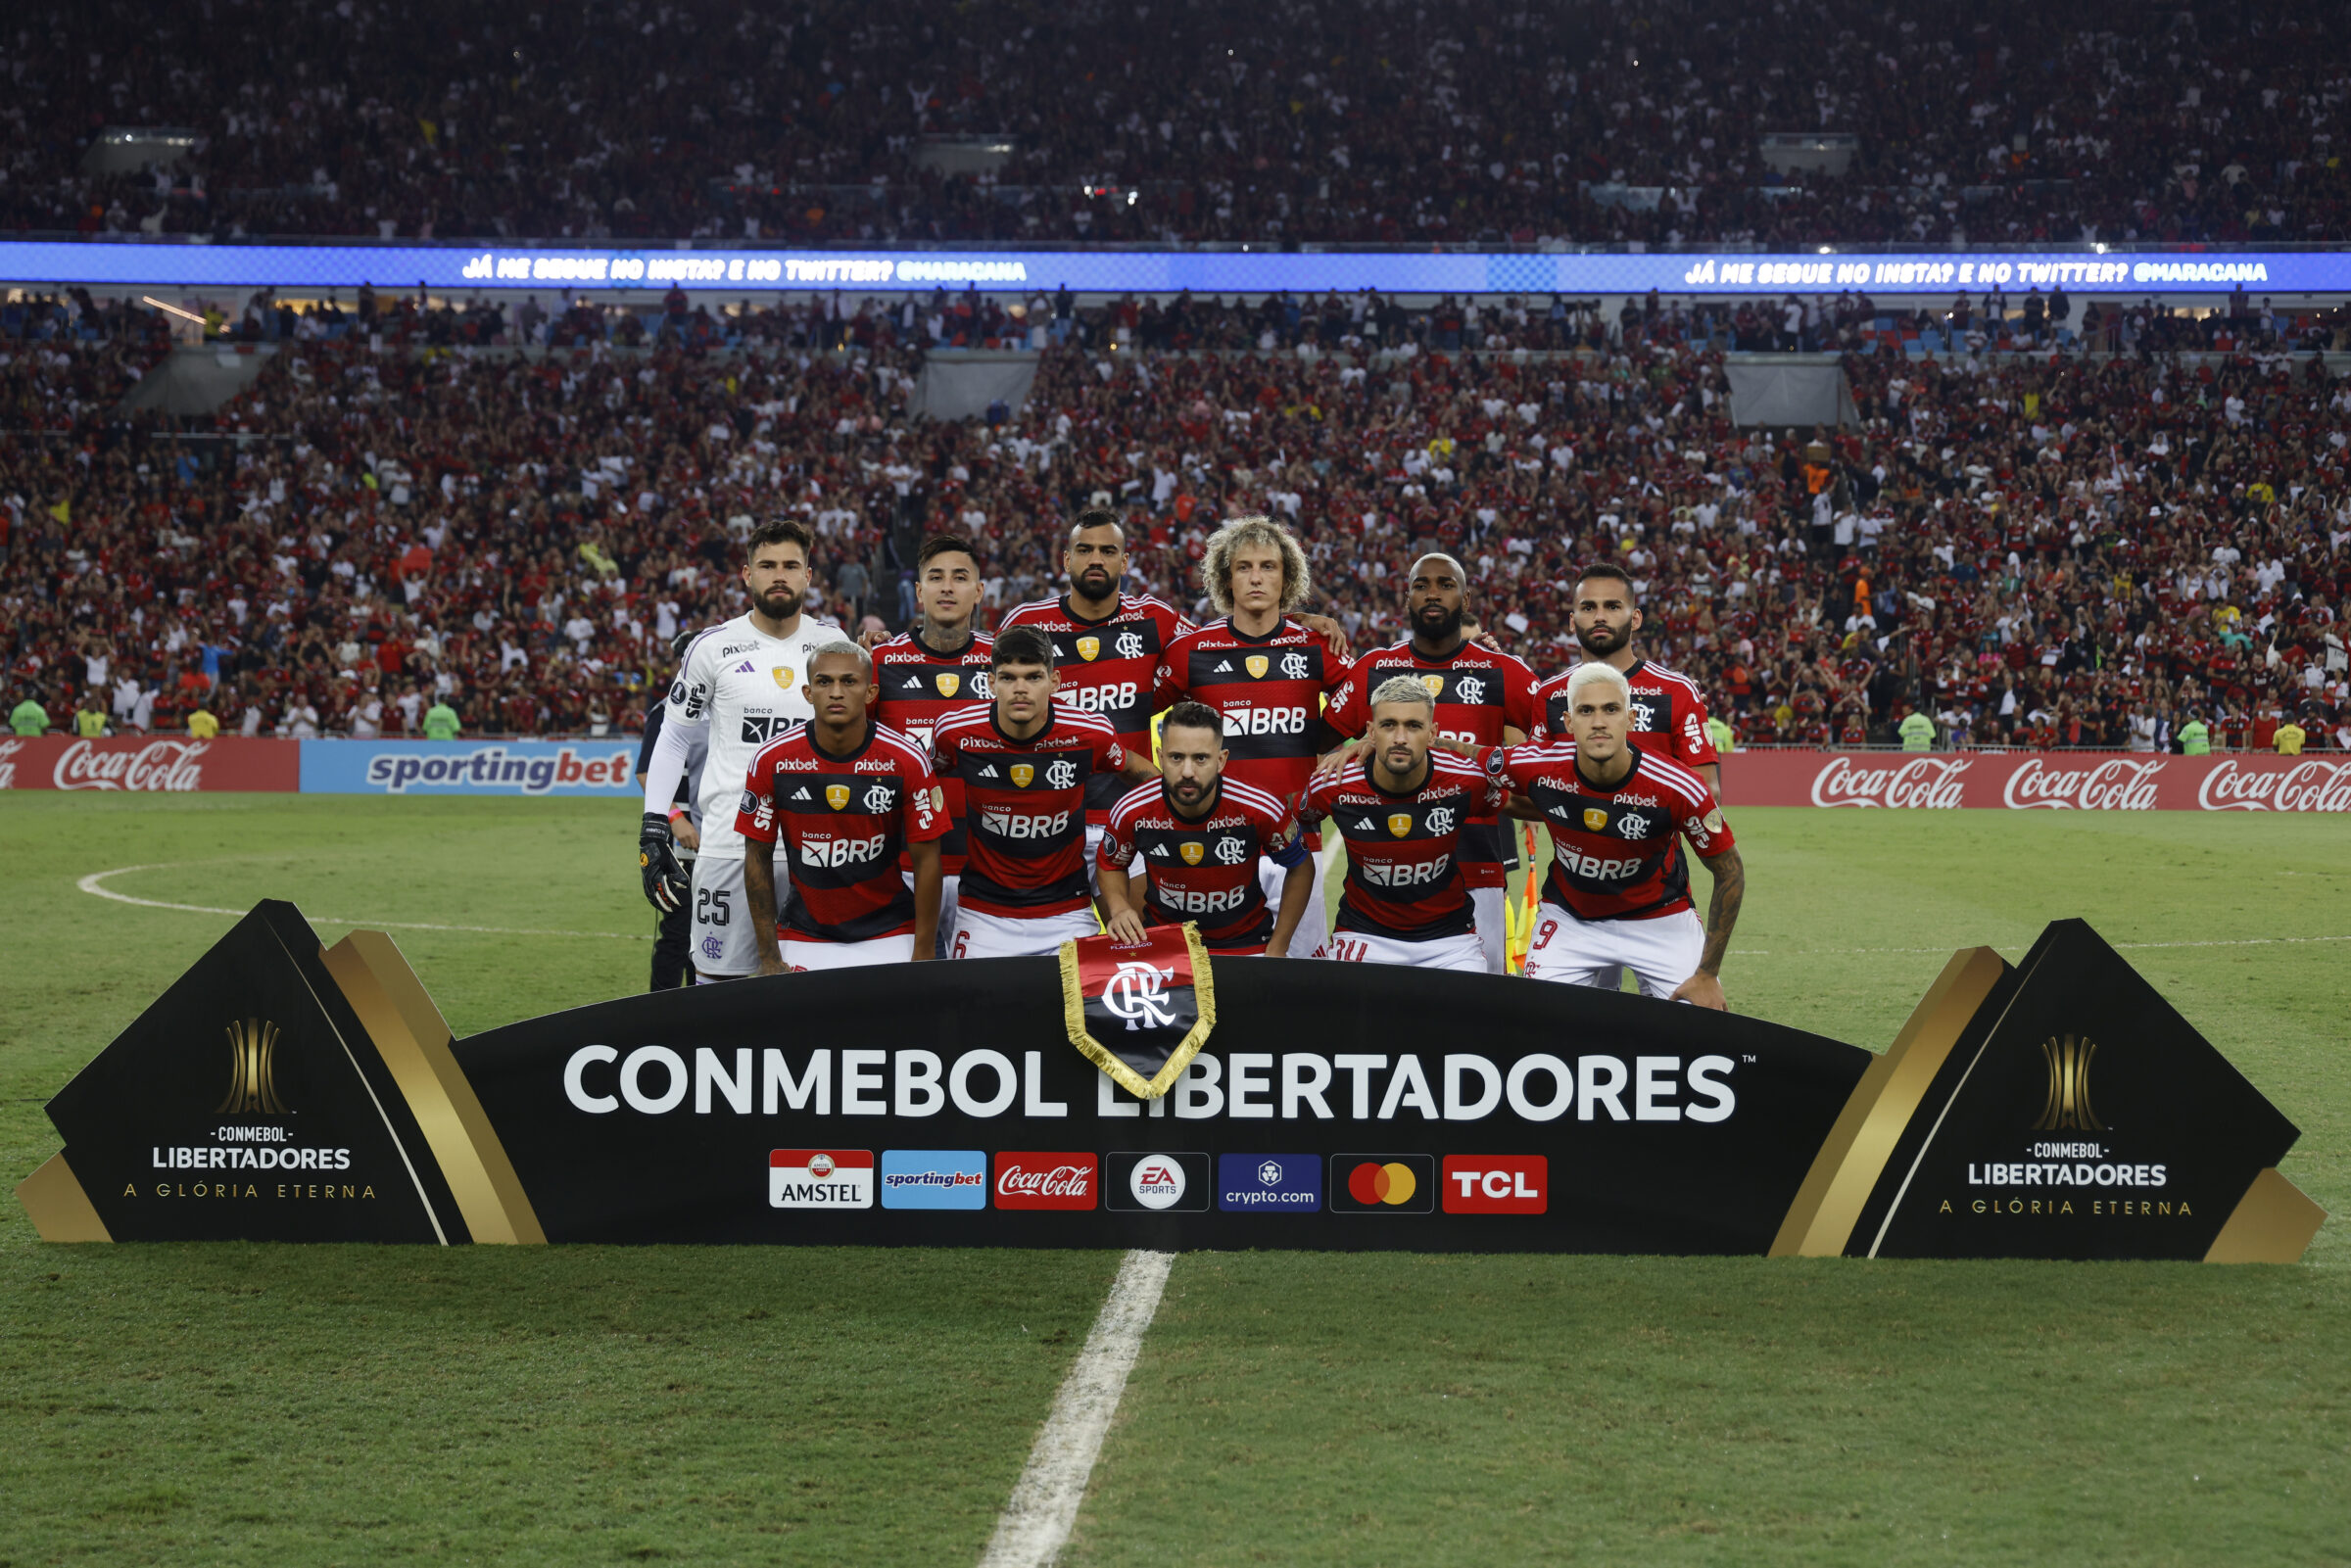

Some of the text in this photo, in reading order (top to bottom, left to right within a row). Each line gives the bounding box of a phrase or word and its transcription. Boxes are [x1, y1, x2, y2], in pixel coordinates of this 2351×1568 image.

[728, 260, 744, 280] E
[1685, 260, 2267, 284] JÁ ME SEGUE NO INSTA? E NO TWITTER? @MARACANA
[722, 641, 760, 658] pixbet
[885, 651, 927, 665] pixbet
[1375, 657, 1415, 670] pixbet
[1452, 659, 1493, 670] pixbet
[1080, 683, 1137, 712] BRB
[1251, 707, 1307, 735] BRB
[960, 736, 1005, 750] pixbet
[1034, 736, 1079, 752] pixbet
[53, 739, 212, 791] Coca-Cola
[368, 747, 633, 793] sportingbet
[776, 757, 819, 774] pixbet
[854, 758, 896, 774] pixbet
[1538, 774, 1580, 794] pixbet
[1811, 756, 1974, 809] Coca-Cola
[2003, 758, 2168, 811] Coca-Cola
[2198, 759, 2351, 812] Coca-Cola
[1338, 793, 1382, 806] pixbet
[1417, 784, 1462, 804] pixbet
[1613, 792, 1658, 808] pixbet
[1009, 810, 1070, 839] BRB
[1134, 817, 1175, 831] pixbet
[1207, 814, 1247, 832] pixbet
[802, 831, 832, 839] banco
[832, 833, 886, 868] BRB
[1393, 853, 1450, 886] BRB
[1579, 858, 1643, 880] BRB
[696, 887, 731, 926] 25
[1186, 885, 1246, 914] BRB
[1532, 920, 1558, 950] 9
[1110, 941, 1153, 950] FLAMENGO
[563, 1044, 1068, 1118] CONMEBOL
[153, 1147, 351, 1169] LIBERTADORES
[885, 1171, 983, 1188] sportingbet
[997, 1164, 1093, 1197] Coca-Cola
[1140, 1166, 1176, 1184] EA
[1452, 1170, 1538, 1198] TCL
[1968, 1164, 2167, 1186] LIBERTADORES
[123, 1180, 375, 1199] A GLÓRIA ETERNA
[782, 1183, 862, 1202] AMSTEL
[1139, 1185, 1176, 1194] SPORTS
[1226, 1190, 1314, 1204] crypto.com
[1940, 1197, 2192, 1215] A GLÓRIA ETERNA
